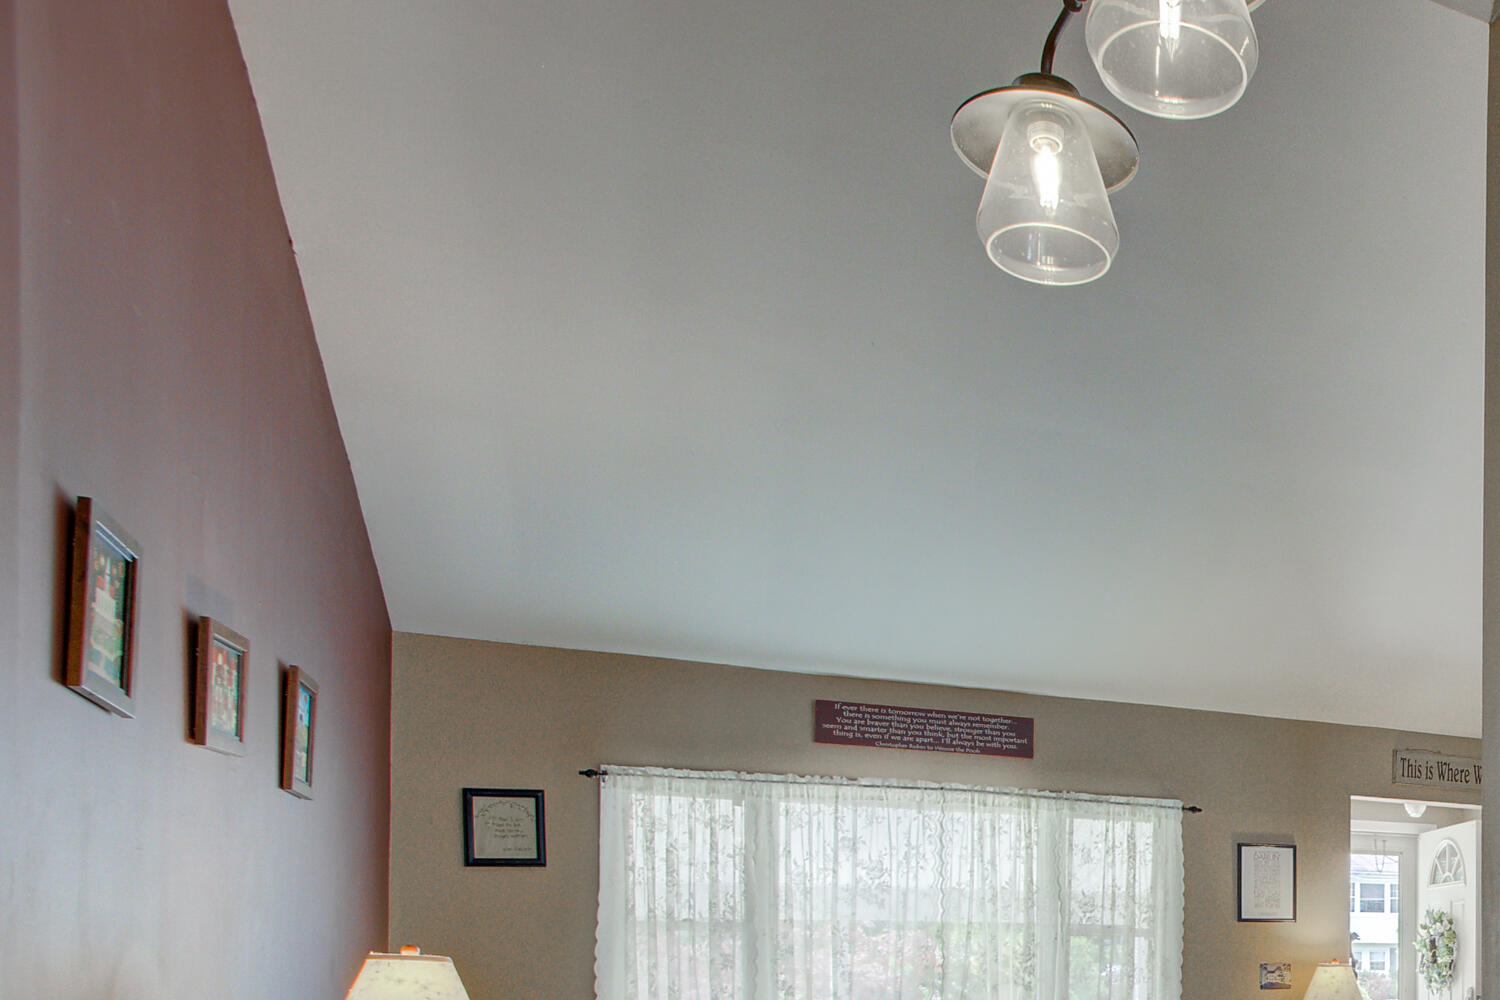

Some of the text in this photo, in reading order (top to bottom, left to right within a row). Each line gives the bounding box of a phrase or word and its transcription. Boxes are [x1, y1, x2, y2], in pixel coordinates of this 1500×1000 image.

[834, 702, 842, 710] If
[888, 708, 926, 717] tomorrow
[872, 714, 910, 723] something
[954, 727, 983, 736] stronger
[833, 729, 853, 738] thing
[952, 739, 974, 747] always
[993, 736, 1028, 744] important
[1400, 756, 1422, 779] This
[1424, 760, 1434, 780] is
[1436, 761, 1470, 784] Where
